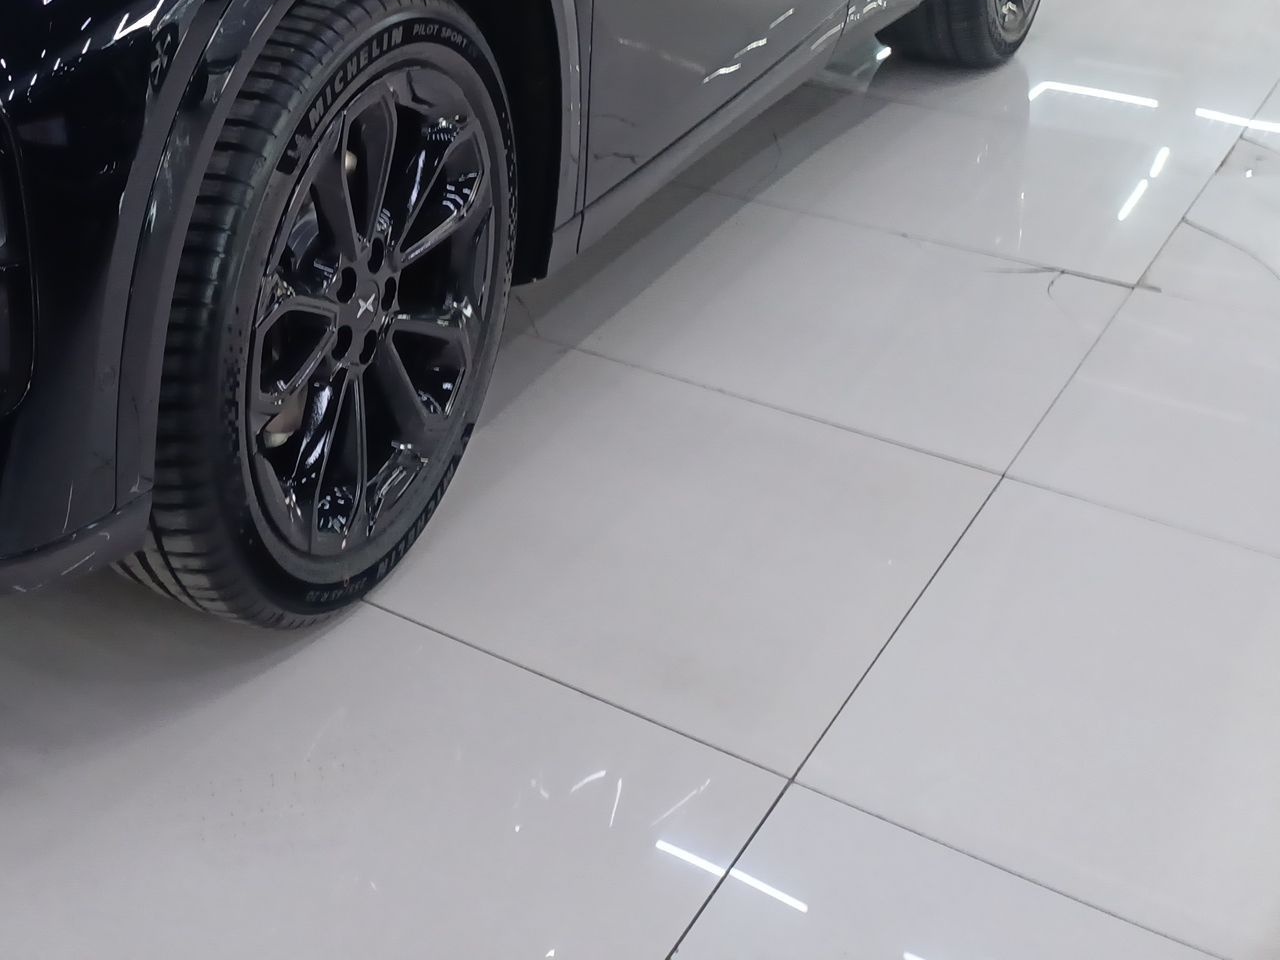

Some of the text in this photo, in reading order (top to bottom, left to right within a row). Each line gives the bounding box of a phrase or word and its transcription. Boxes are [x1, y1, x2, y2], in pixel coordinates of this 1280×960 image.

[308, 23, 468, 130] MICHELIN PILOT SPORT
